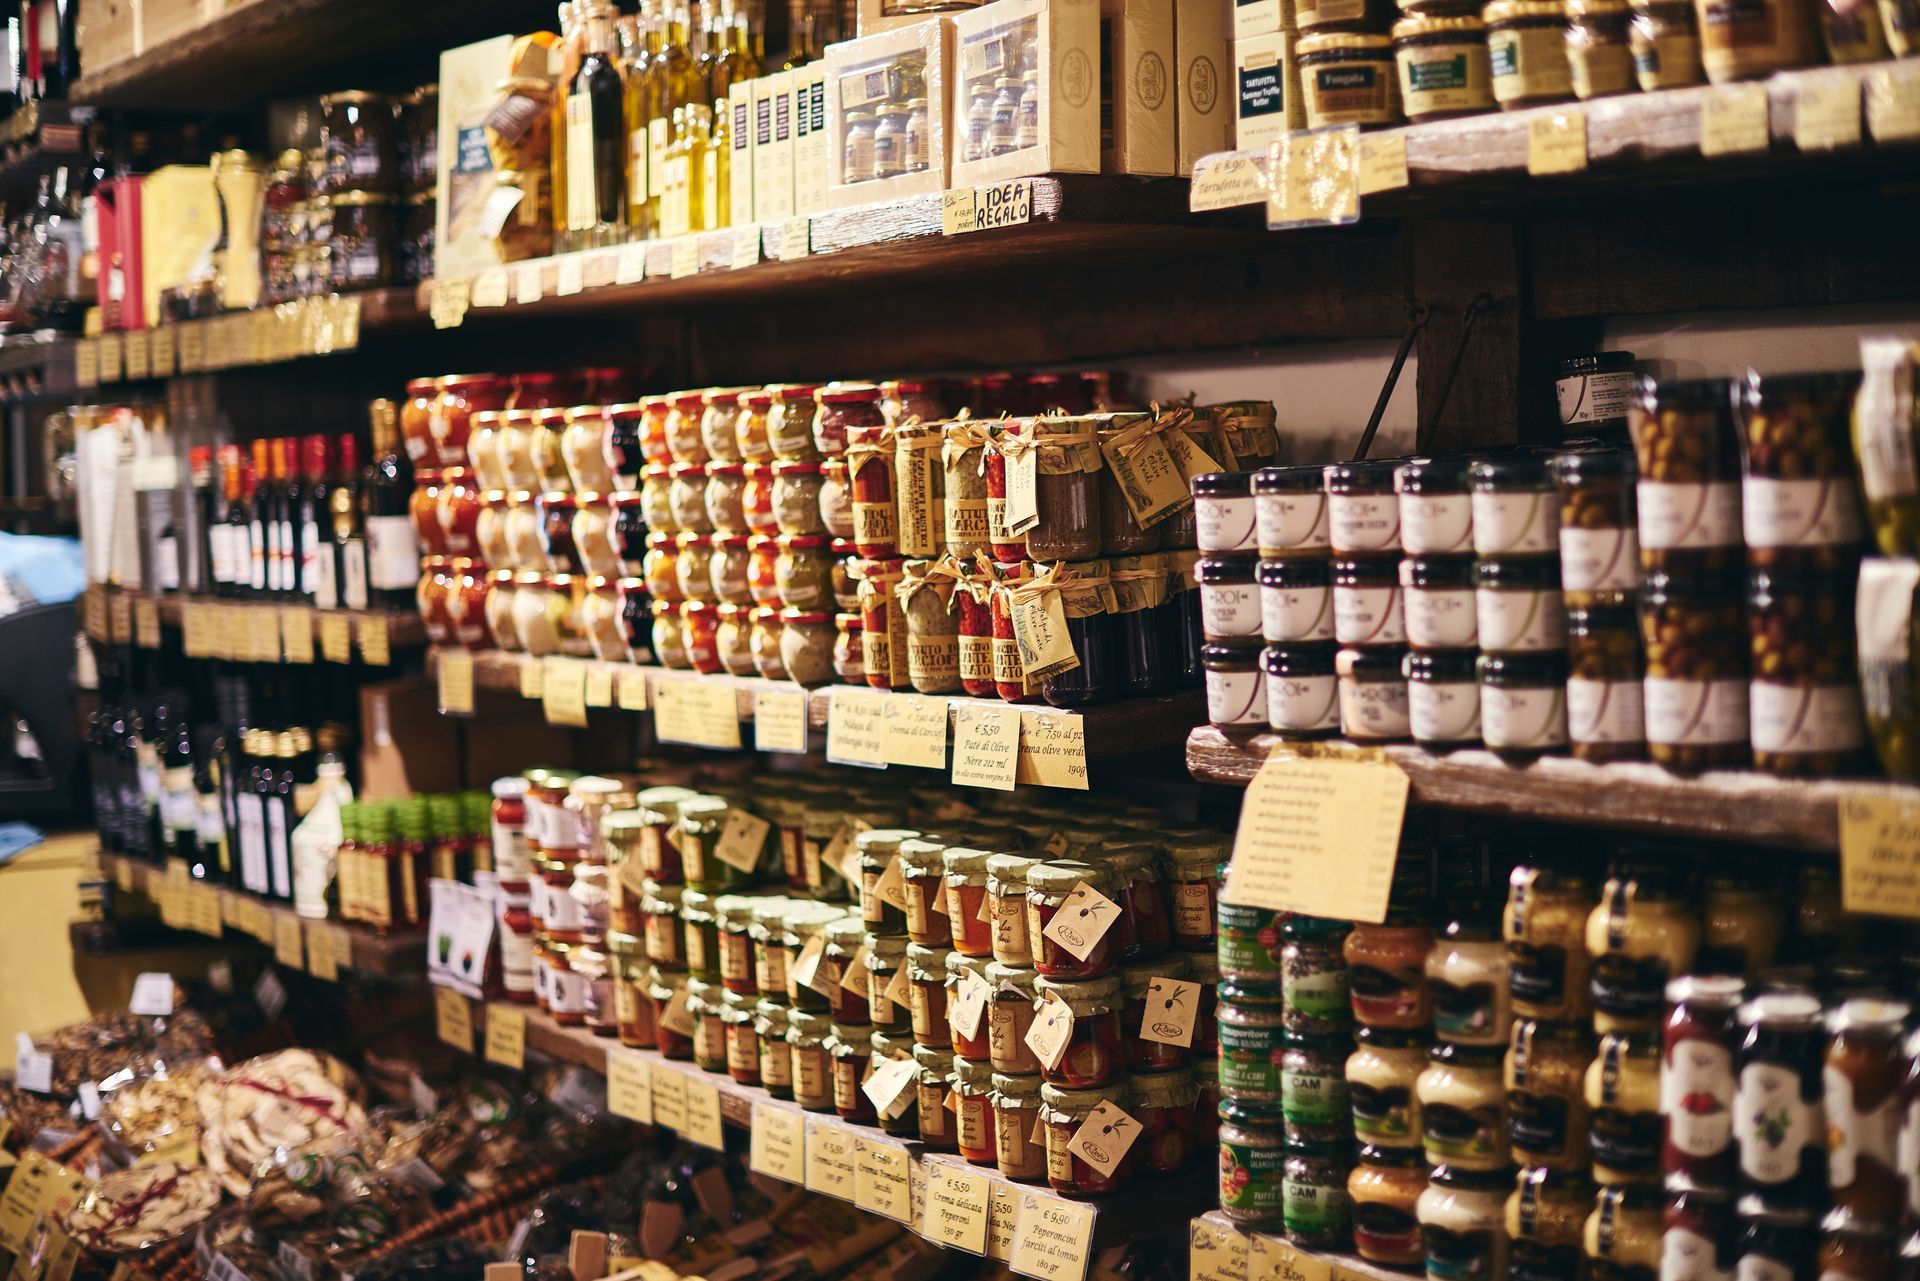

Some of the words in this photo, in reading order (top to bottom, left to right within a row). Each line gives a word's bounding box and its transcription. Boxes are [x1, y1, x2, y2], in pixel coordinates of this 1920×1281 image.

[1245, 75, 1276, 89] TARTUFETTA
[1242, 90, 1263, 101] Summer
[1198, 178, 1241, 195] Tartufetta
[976, 203, 1028, 229] REGALO
[888, 724, 910, 734] Crema
[974, 724, 981, 734] €
[981, 724, 1001, 736] 5,50
[1035, 729, 1041, 738] €
[1045, 729, 1062, 740] 7,50
[1063, 727, 1074, 740] al
[1070, 730, 1083, 743] pz
[981, 740, 990, 751] di
[990, 741, 1010, 753] Olive
[1041, 743, 1061, 756] olive
[1063, 745, 1086, 757] verdi
[963, 755, 982, 766] Nere
[983, 759, 994, 768] 212
[996, 758, 1009, 769] ml
[1067, 764, 1087, 778] 190g
[1292, 1077, 1321, 1090] CAM
[858, 1162, 879, 1176] Crema
[947, 1180, 952, 1188] €
[952, 1180, 971, 1193] 5,50
[1290, 1185, 1317, 1199] CAM
[934, 1192, 955, 1206] Crema
[955, 1194, 983, 1214] delicata
[994, 1201, 1013, 1215] 5,50
[940, 1209, 971, 1226] Peperoni
[1043, 1209, 1050, 1219] €
[1050, 1211, 1070, 1226] 9,90
[1002, 1219, 1017, 1233] Noc
[943, 1226, 954, 1236] 130
[955, 1230, 964, 1241] gr
[1032, 1224, 1078, 1246] Peperoncini
[1001, 1237, 1011, 1247] gr
[1021, 1237, 1047, 1254] farciti
[1047, 1241, 1057, 1255] al
[1056, 1248, 1079, 1262] tonno
[1036, 1259, 1048, 1270] 180
[1048, 1264, 1060, 1275] gr
[1274, 1264, 1281, 1275] €
[1283, 1266, 1305, 1281] 3,00
